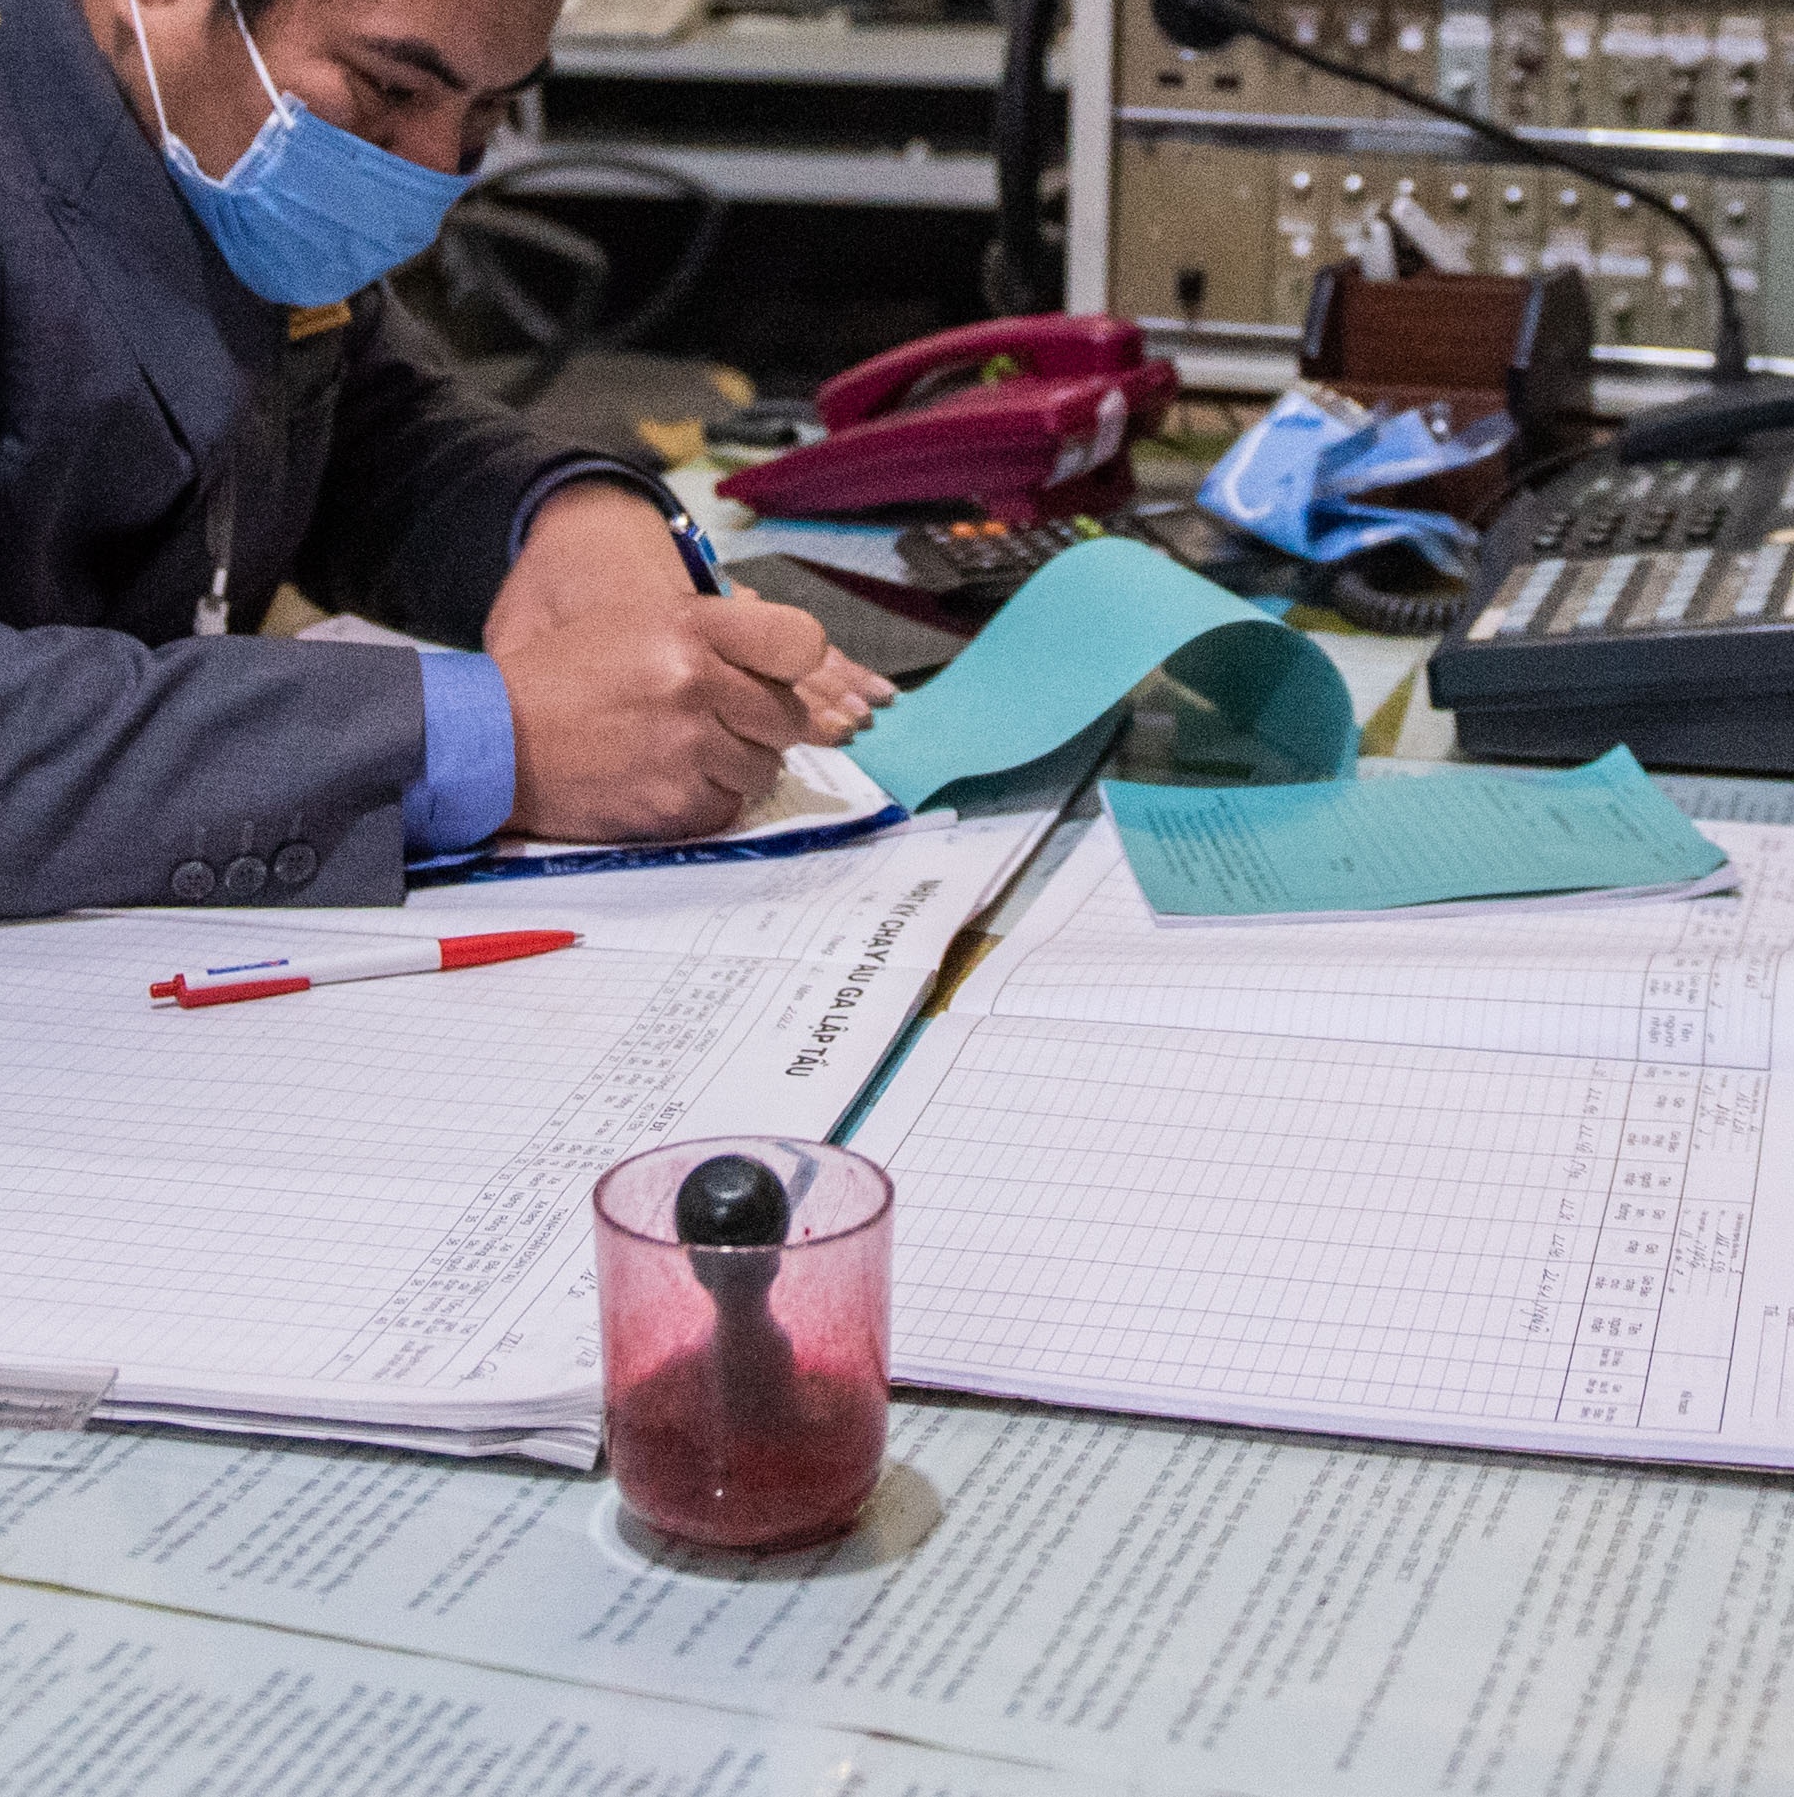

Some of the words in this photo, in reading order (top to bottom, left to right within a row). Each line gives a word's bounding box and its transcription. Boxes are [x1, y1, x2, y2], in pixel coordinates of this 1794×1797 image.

[862, 920, 905, 963] CHẠY
[830, 987, 863, 1009] GA
[808, 1015, 849, 1044] LẬP
